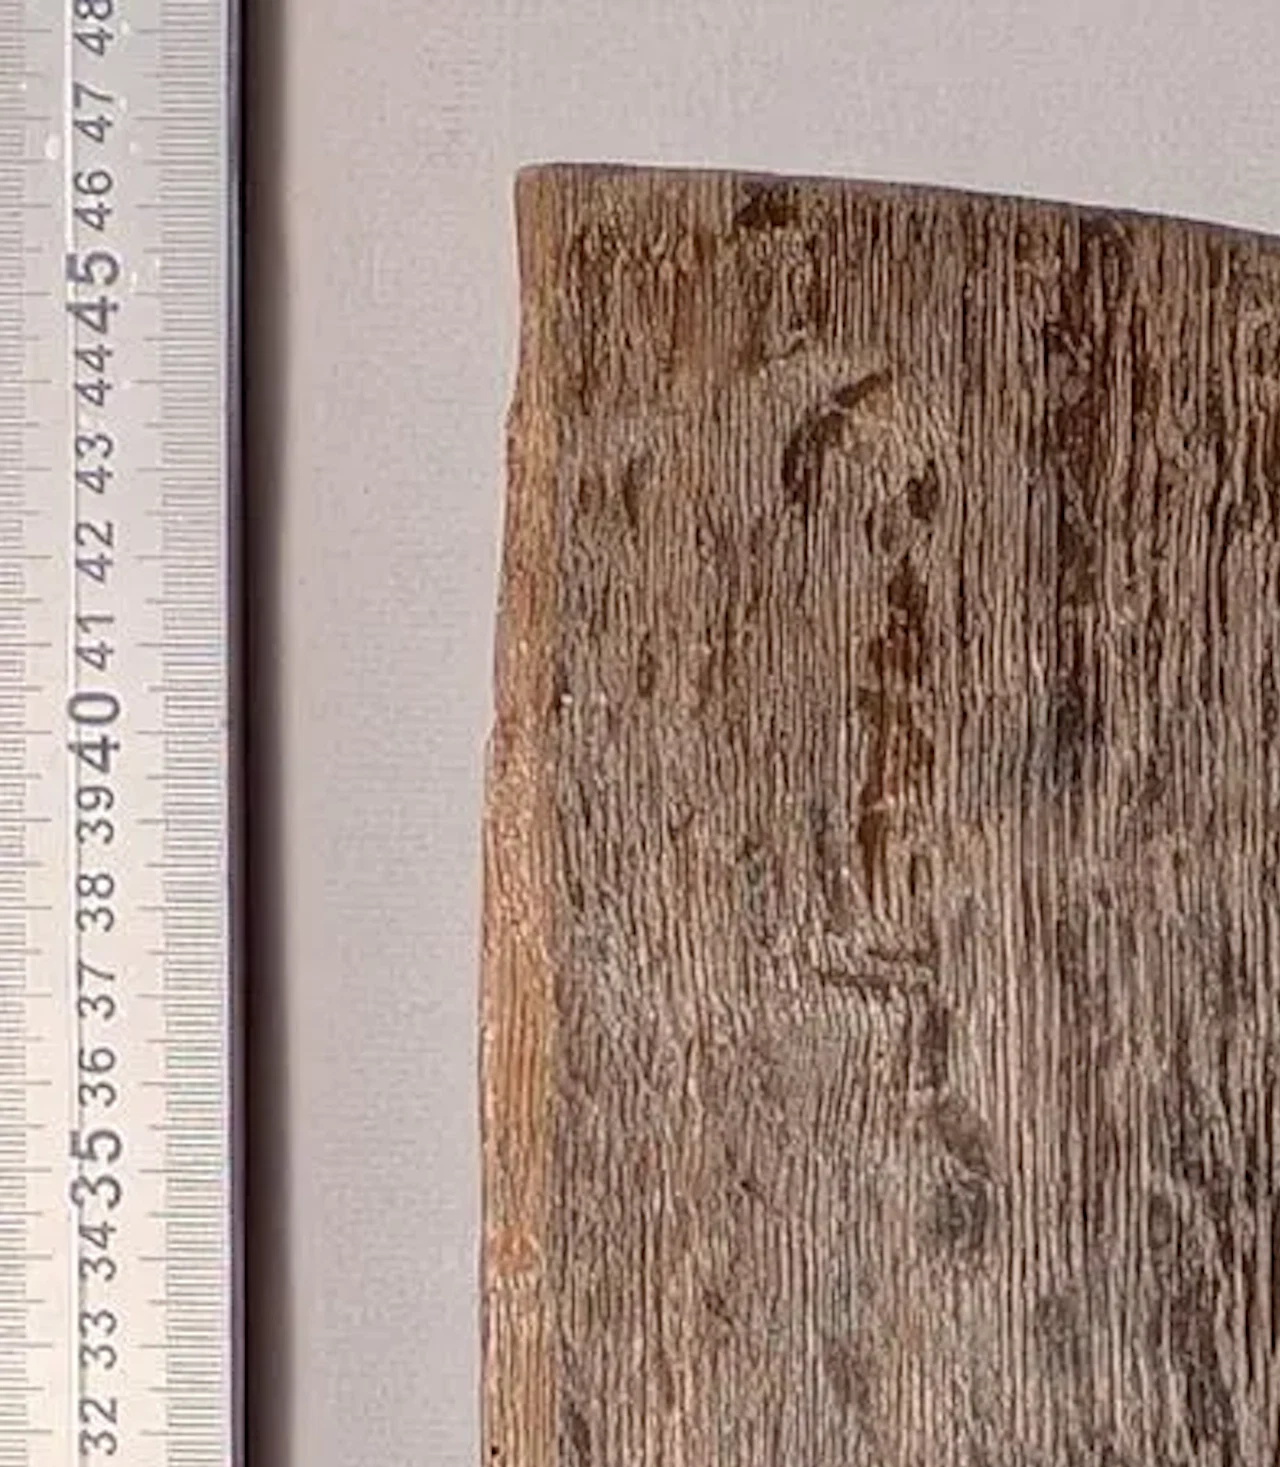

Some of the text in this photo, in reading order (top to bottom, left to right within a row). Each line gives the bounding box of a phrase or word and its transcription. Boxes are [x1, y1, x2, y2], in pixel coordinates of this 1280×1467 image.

[74, 0, 114, 56] 48
[74, 84, 114, 143] 47
[74, 169, 113, 231] 46
[67, 251, 120, 334] 45
[74, 344, 113, 406] 44
[75, 432, 114, 494] 43
[75, 521, 114, 584] 42
[75, 614, 115, 672] 41
[68, 692, 121, 774] 40
[75, 785, 115, 844] 39
[76, 873, 115, 931] 38
[76, 959, 116, 1021] 37
[77, 1047, 117, 1107] 36
[71, 1130, 123, 1210] 35
[77, 1220, 117, 1282] 34
[77, 1309, 117, 1370] 33
[77, 1398, 118, 1456] 32
